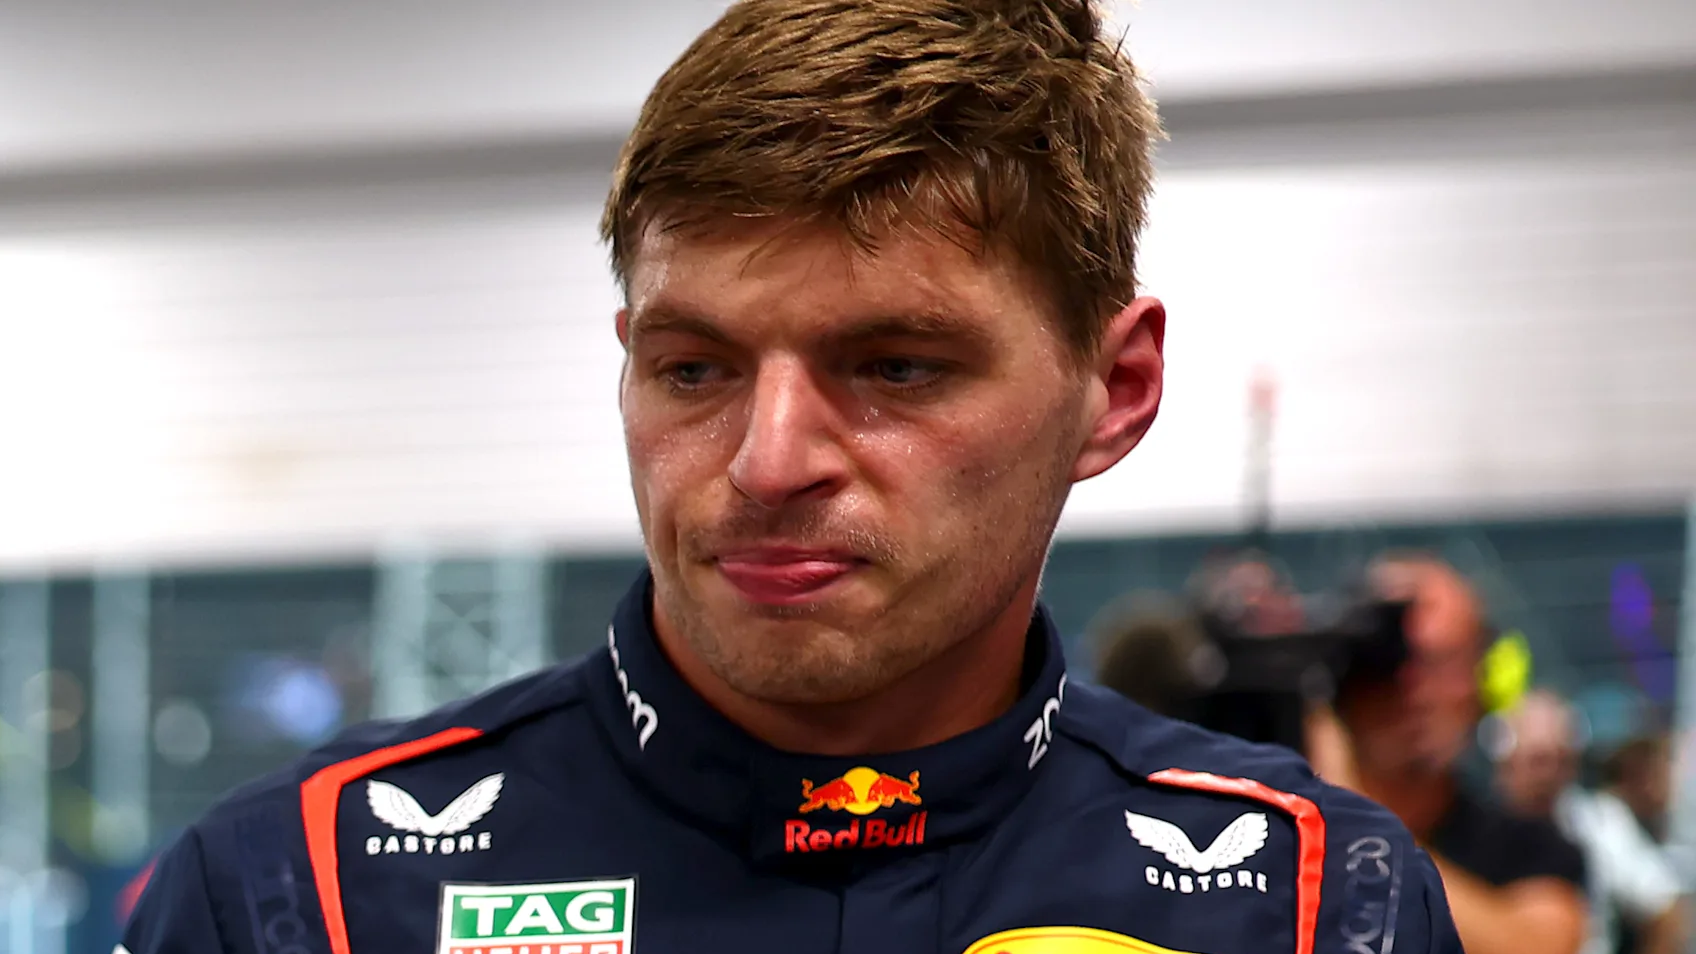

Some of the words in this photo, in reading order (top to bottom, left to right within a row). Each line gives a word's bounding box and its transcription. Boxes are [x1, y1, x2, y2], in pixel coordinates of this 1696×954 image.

[365, 831, 493, 856] CASTORE
[784, 817, 860, 853] Red
[861, 810, 929, 850] Bull
[1144, 866, 1269, 894] CASTORE
[460, 891, 615, 937] TAG
